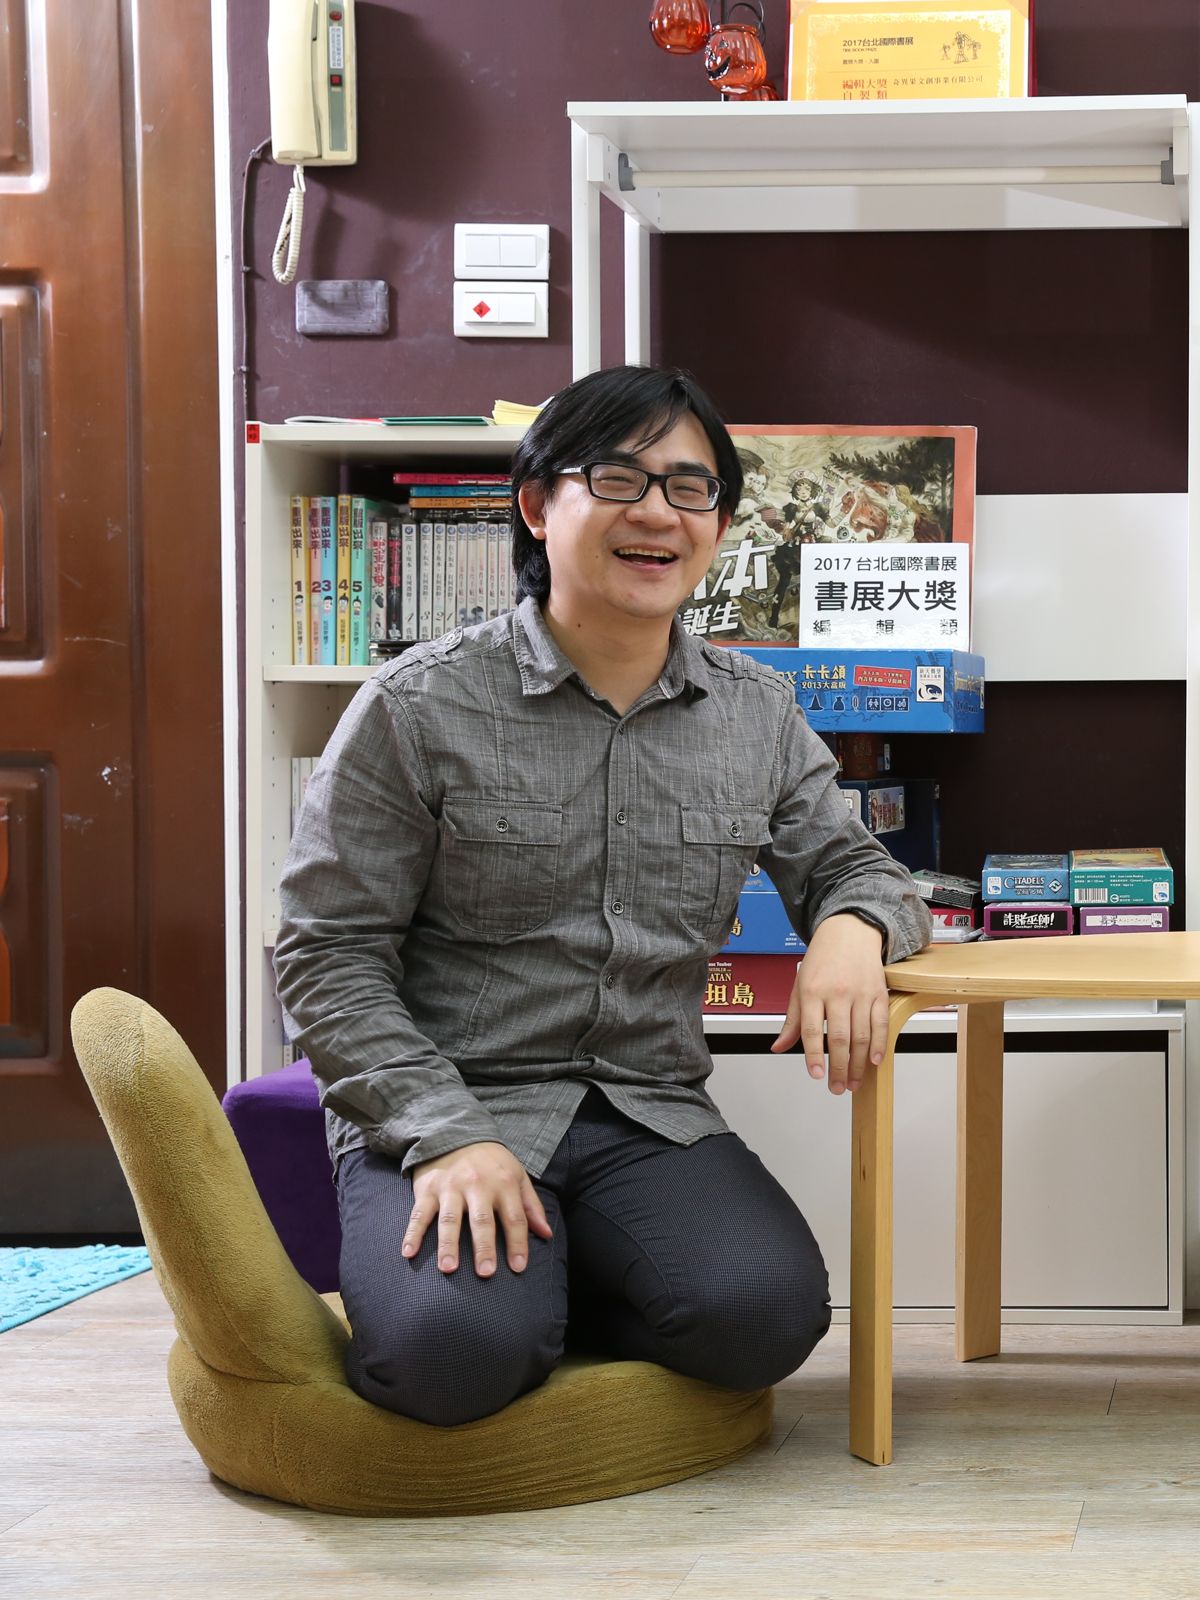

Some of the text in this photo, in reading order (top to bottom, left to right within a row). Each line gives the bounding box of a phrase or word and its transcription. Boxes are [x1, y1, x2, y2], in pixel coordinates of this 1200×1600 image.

[842, 36, 914, 47] 2017台北國際書展
[842, 78, 888, 90] 編輯大獎
[814, 556, 957, 571] 2017 台北國際書展
[690, 539, 775, 601] 本
[295, 581, 302, 592] 1
[312, 582, 321, 593] 2
[322, 580, 332, 592] 3
[339, 579, 349, 590] 4
[352, 581, 363, 592] 5
[814, 580, 957, 611] 書展大獎
[813, 619, 958, 636] 編輯類
[1003, 912, 1054, 926] 詐賭巫師!
